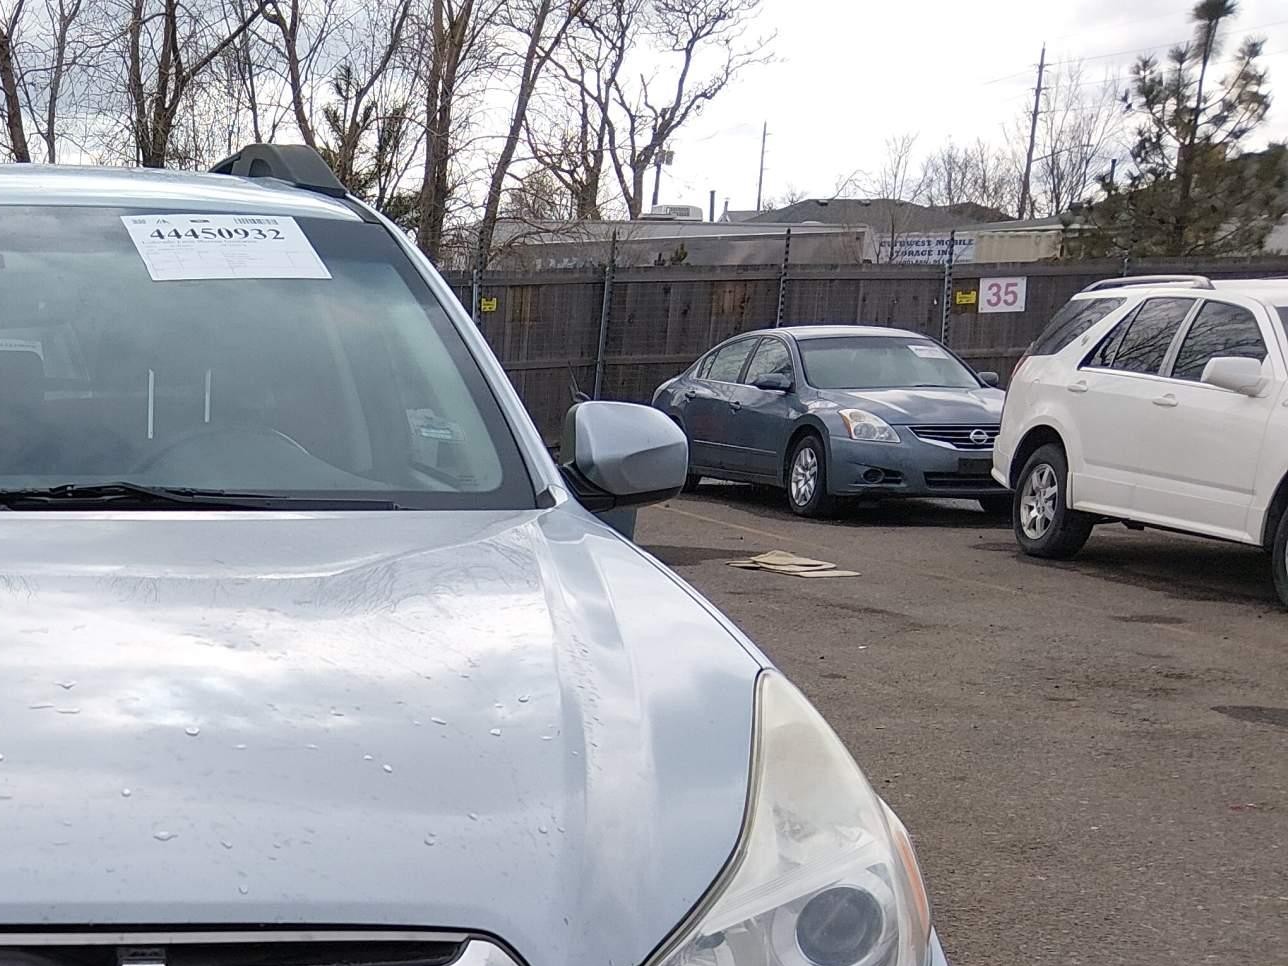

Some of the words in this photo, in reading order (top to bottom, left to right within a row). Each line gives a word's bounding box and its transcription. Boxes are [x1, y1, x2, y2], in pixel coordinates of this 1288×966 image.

[149, 227, 285, 240] 44450932
[890, 249, 934, 257] TORAGE
[986, 282, 1018, 307] 35
